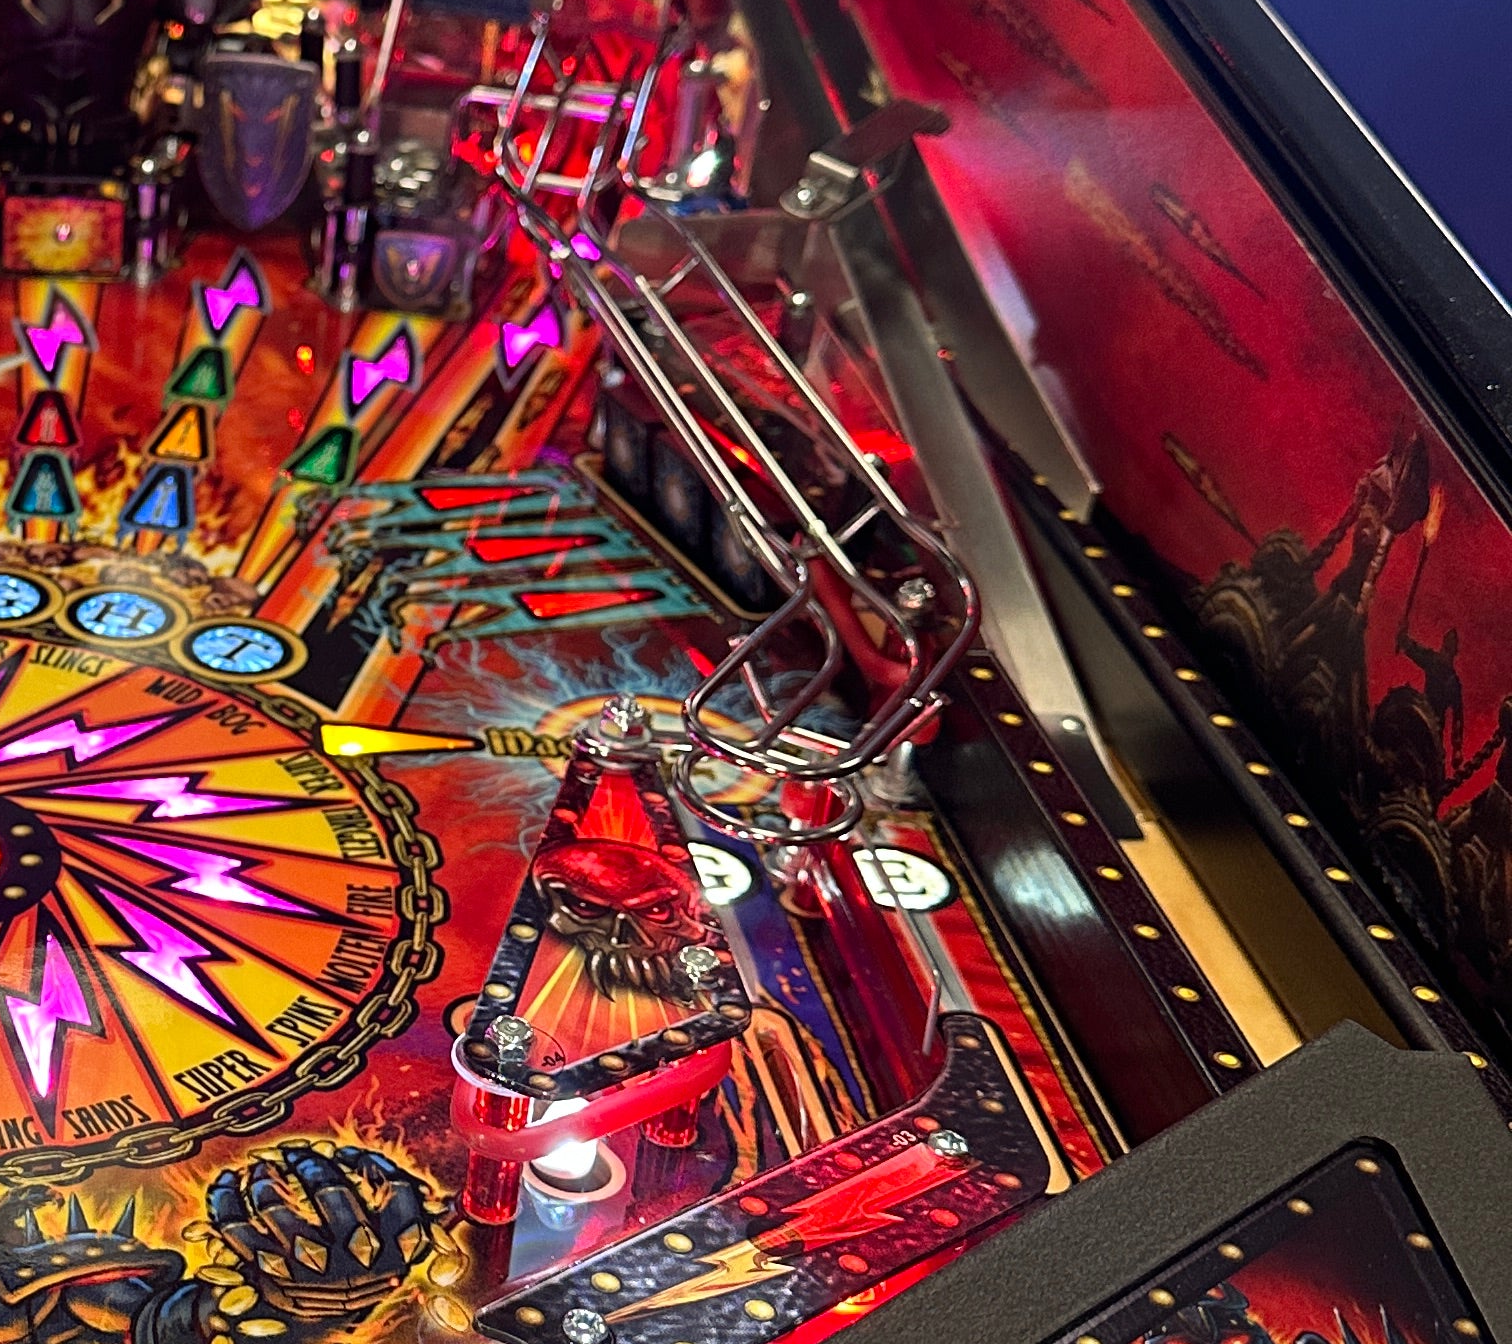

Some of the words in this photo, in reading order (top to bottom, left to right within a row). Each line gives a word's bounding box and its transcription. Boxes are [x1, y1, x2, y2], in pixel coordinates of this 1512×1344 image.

[29, 643, 113, 678] SLINGS
[145, 674, 201, 707] MUD
[204, 702, 266, 736] BOG
[275, 752, 348, 797] SUPER
[323, 803, 387, 860] TARGET
[346, 883, 395, 919] FIRE
[315, 928, 392, 994] MOLTEN
[172, 1048, 274, 1105] SUPER
[265, 994, 345, 1049] SPINS
[61, 1094, 153, 1140] SANDS
